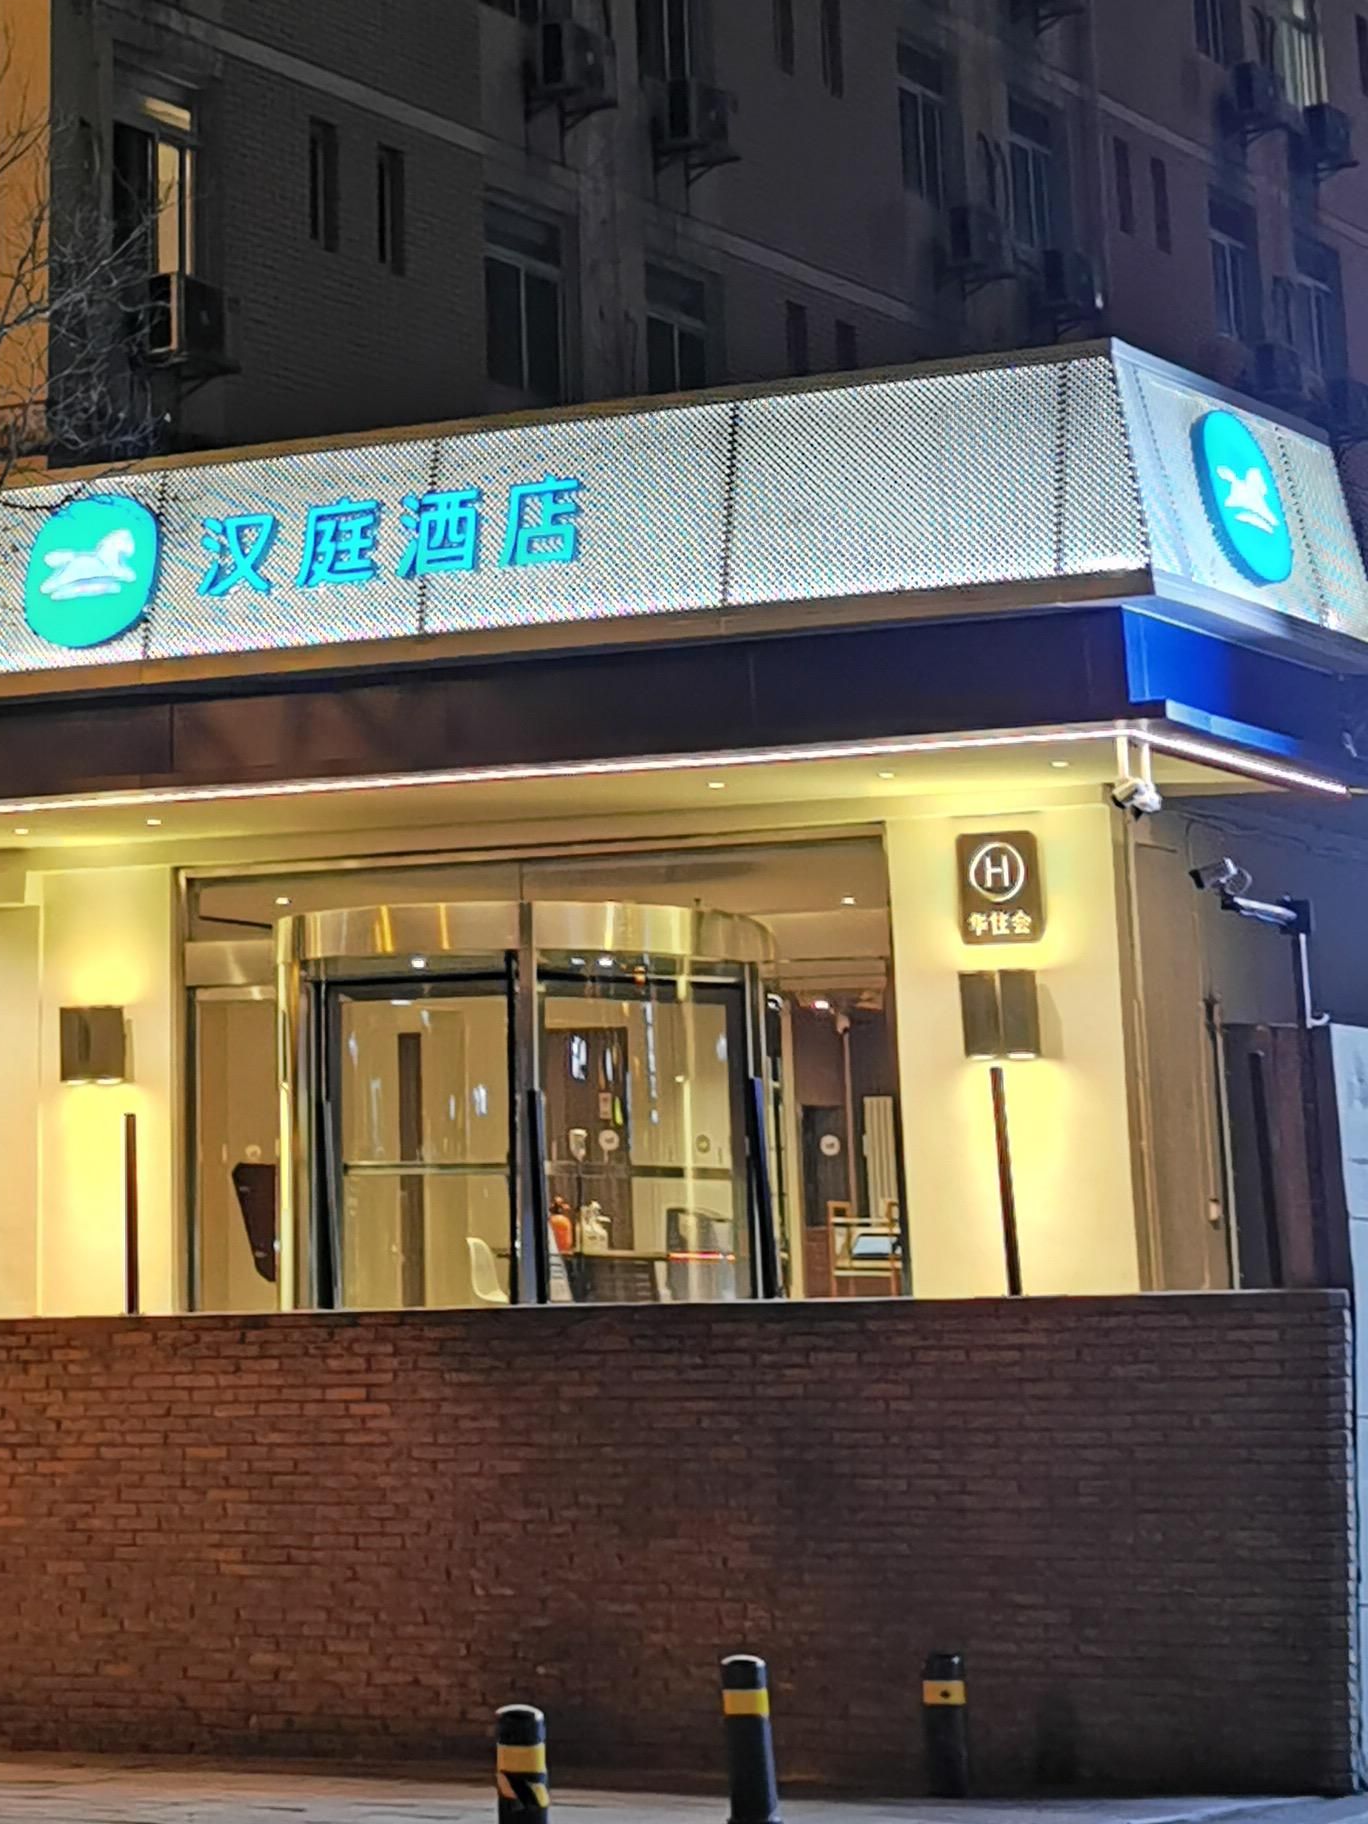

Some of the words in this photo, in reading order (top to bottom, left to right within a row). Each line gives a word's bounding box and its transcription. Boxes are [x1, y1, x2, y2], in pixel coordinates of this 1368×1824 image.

[197, 475, 582, 596] 汉庭酒店
[984, 854, 1010, 888] H
[967, 909, 1032, 936] 华住会
